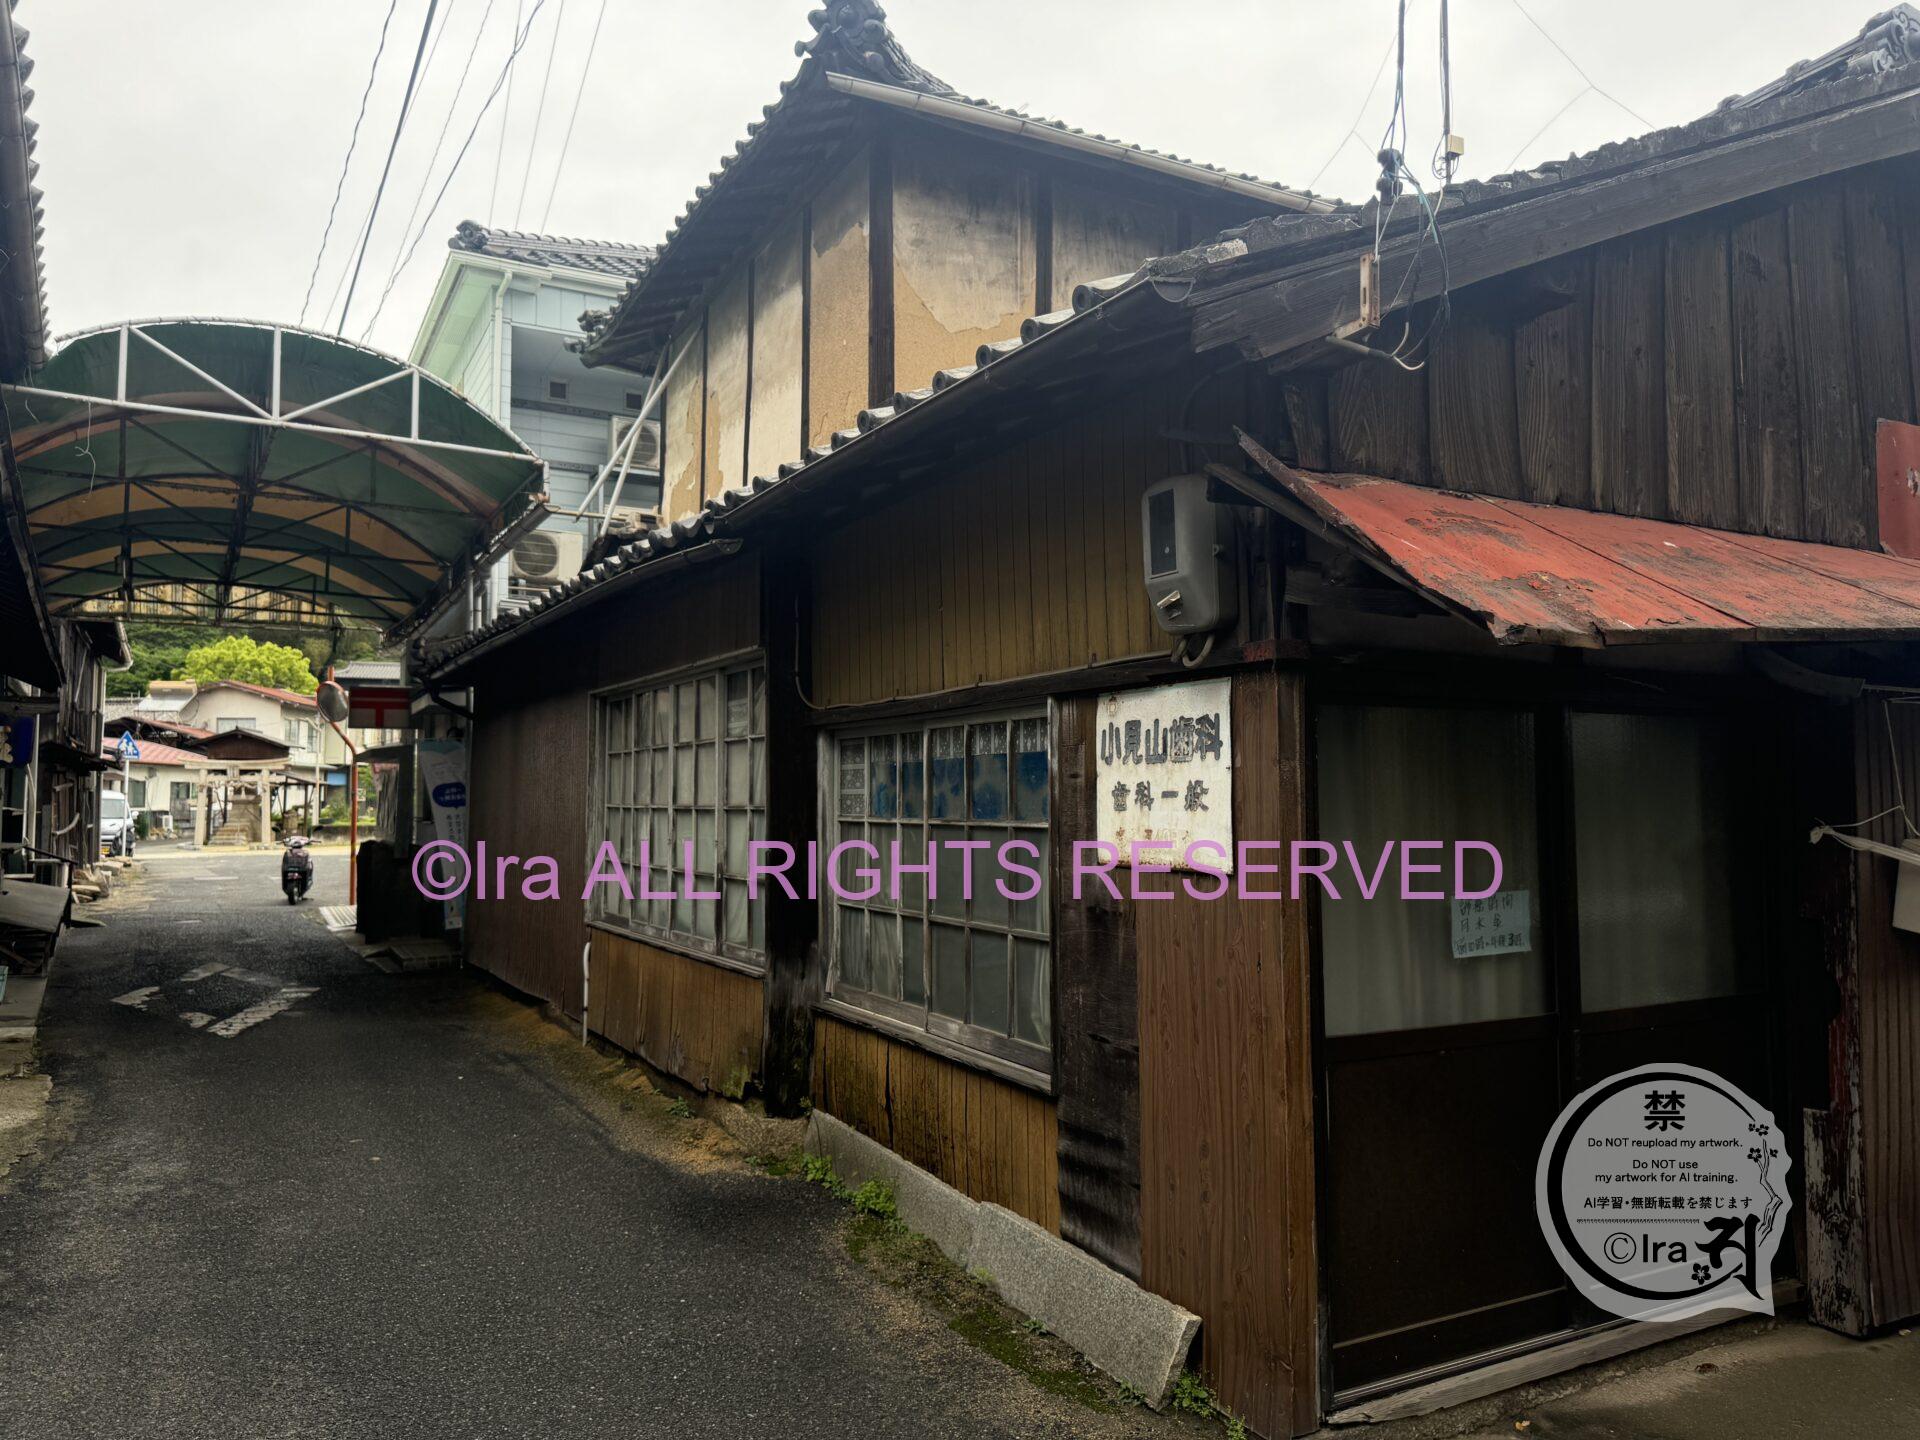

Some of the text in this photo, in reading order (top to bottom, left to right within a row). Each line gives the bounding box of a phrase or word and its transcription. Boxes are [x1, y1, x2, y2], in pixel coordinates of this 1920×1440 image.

[1101, 713, 1224, 765] 小見山歯科
[1111, 780, 1210, 812] 歯科一般
